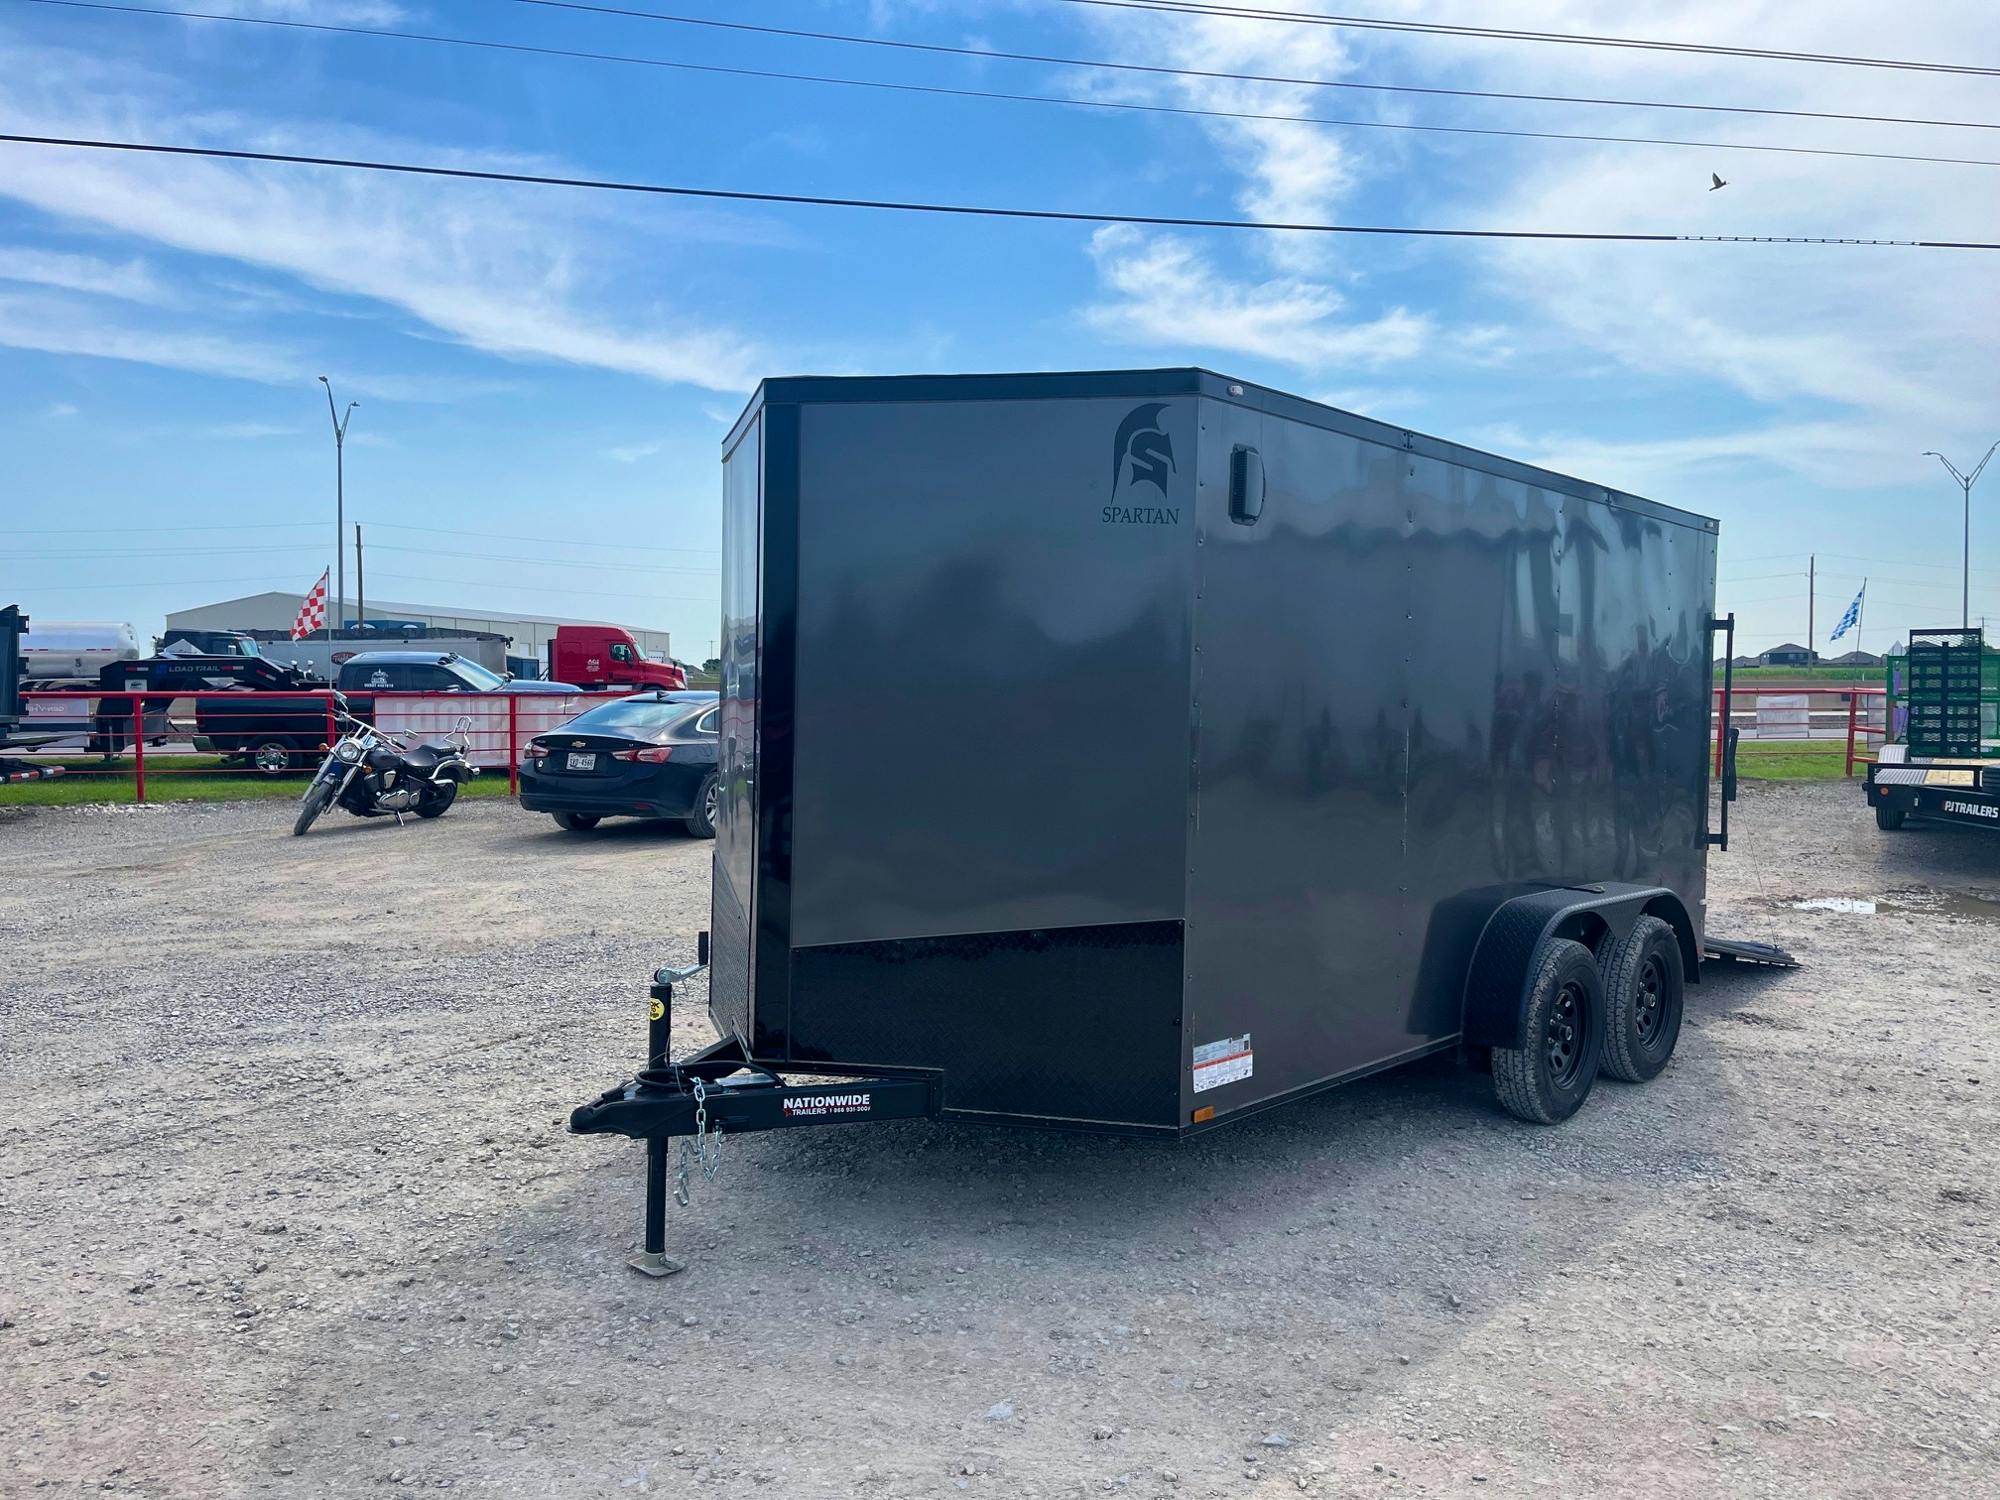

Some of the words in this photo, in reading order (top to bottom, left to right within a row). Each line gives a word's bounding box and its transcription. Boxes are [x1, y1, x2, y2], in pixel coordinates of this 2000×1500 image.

[1102, 506, 1180, 525] SPARTAN
[169, 665, 193, 673] LOAD
[783, 1094, 870, 1109] NATIONWIDE
[792, 1107, 827, 1116] TRAILERS
